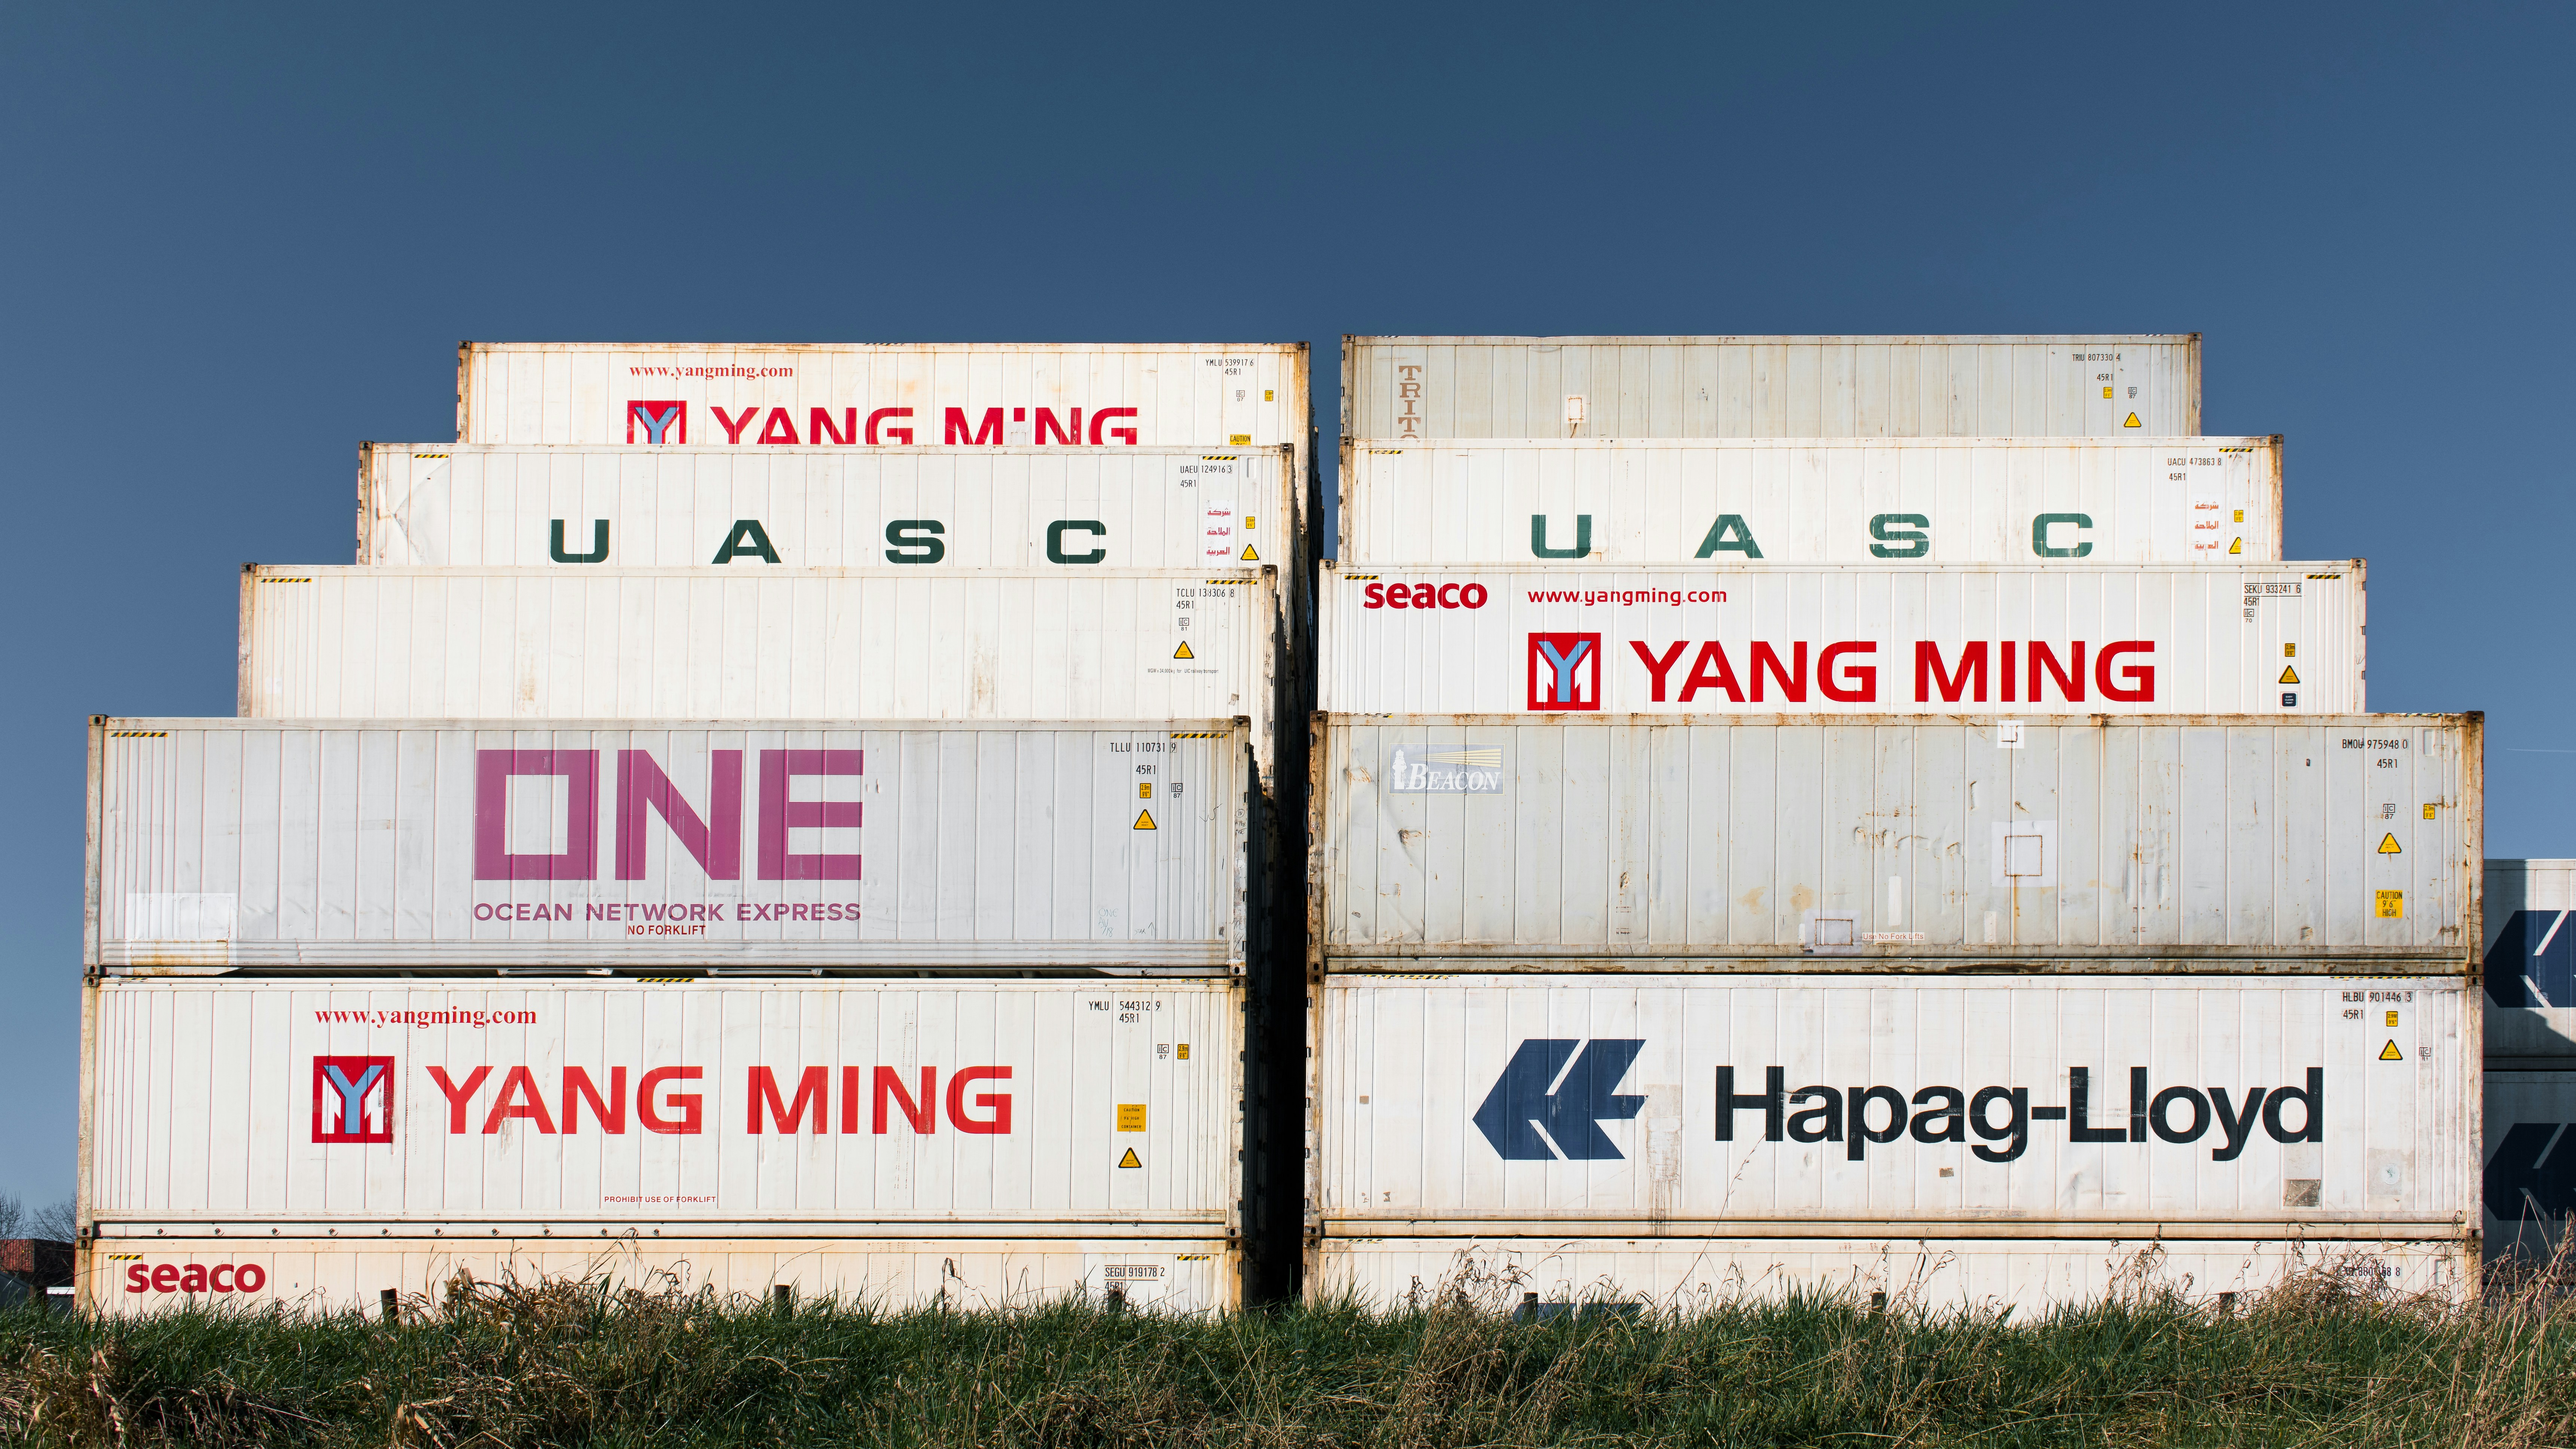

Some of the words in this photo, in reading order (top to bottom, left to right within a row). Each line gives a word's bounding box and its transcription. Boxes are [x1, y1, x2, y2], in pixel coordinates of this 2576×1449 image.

[629, 363, 793, 381] www.yangming.com
[1398, 365, 1422, 438] TRIT
[710, 406, 913, 445] YANG
[945, 407, 1137, 445] MNG
[2195, 501, 2219, 510] شركة
[1207, 507, 1231, 517] شركة
[2195, 521, 2219, 530] الملاحة
[1207, 527, 1230, 536] الملاحة
[1206, 546, 1230, 556] العربية
[1176, 589, 1194, 597] TCLU
[1230, 589, 1234, 597] 8
[2244, 585, 2262, 594] SEKU
[2266, 585, 2291, 594] 933241
[2296, 585, 2301, 593] 6
[1363, 582, 1488, 609] seaco
[1528, 588, 1727, 606] www.yangming.com
[1176, 601, 1194, 609] 45R1
[2244, 597, 2259, 606] 45R1
[1629, 641, 1877, 702] YANG
[1915, 641, 2155, 702] MING
[1110, 742, 1131, 752] TLLU
[1137, 742, 1165, 752] 110731
[1171, 743, 1176, 752] 9
[2367, 739, 2399, 749] 975948
[2402, 740, 2407, 749] 0
[2377, 759, 2398, 768] 45R1
[1136, 765, 1156, 774] 45R1
[474, 750, 863, 880] ONE
[474, 902, 572, 921] OCEAN
[586, 903, 724, 921] NETWORK
[737, 902, 860, 921] EXPRESS
[1099, 908, 1118, 917] ONE
[628, 925, 645, 935] NO
[648, 925, 706, 935] FORKLIFT
[2342, 992, 2364, 1002] HLBU
[2370, 992, 2401, 1002] 901446
[2406, 992, 2411, 1002] 3
[1089, 1001, 1109, 1010] YMLU
[1120, 1001, 1150, 1011] 544312
[1156, 1001, 1160, 1010] 9
[315, 1006, 537, 1029] www.yangming.com
[1119, 1013, 1139, 1023] 45R1
[2343, 1010, 2363, 1019] 45R1
[425, 1066, 703, 1135] YANG
[747, 1066, 1012, 1134] MING
[1716, 1066, 2323, 1161] Hapag-Lloyd
[1105, 1268, 1125, 1276] SEGU
[1129, 1267, 1157, 1276] 919178
[1160, 1267, 1165, 1276] 2
[2396, 1267, 2400, 1276] 8
[125, 1264, 266, 1293] seaco
